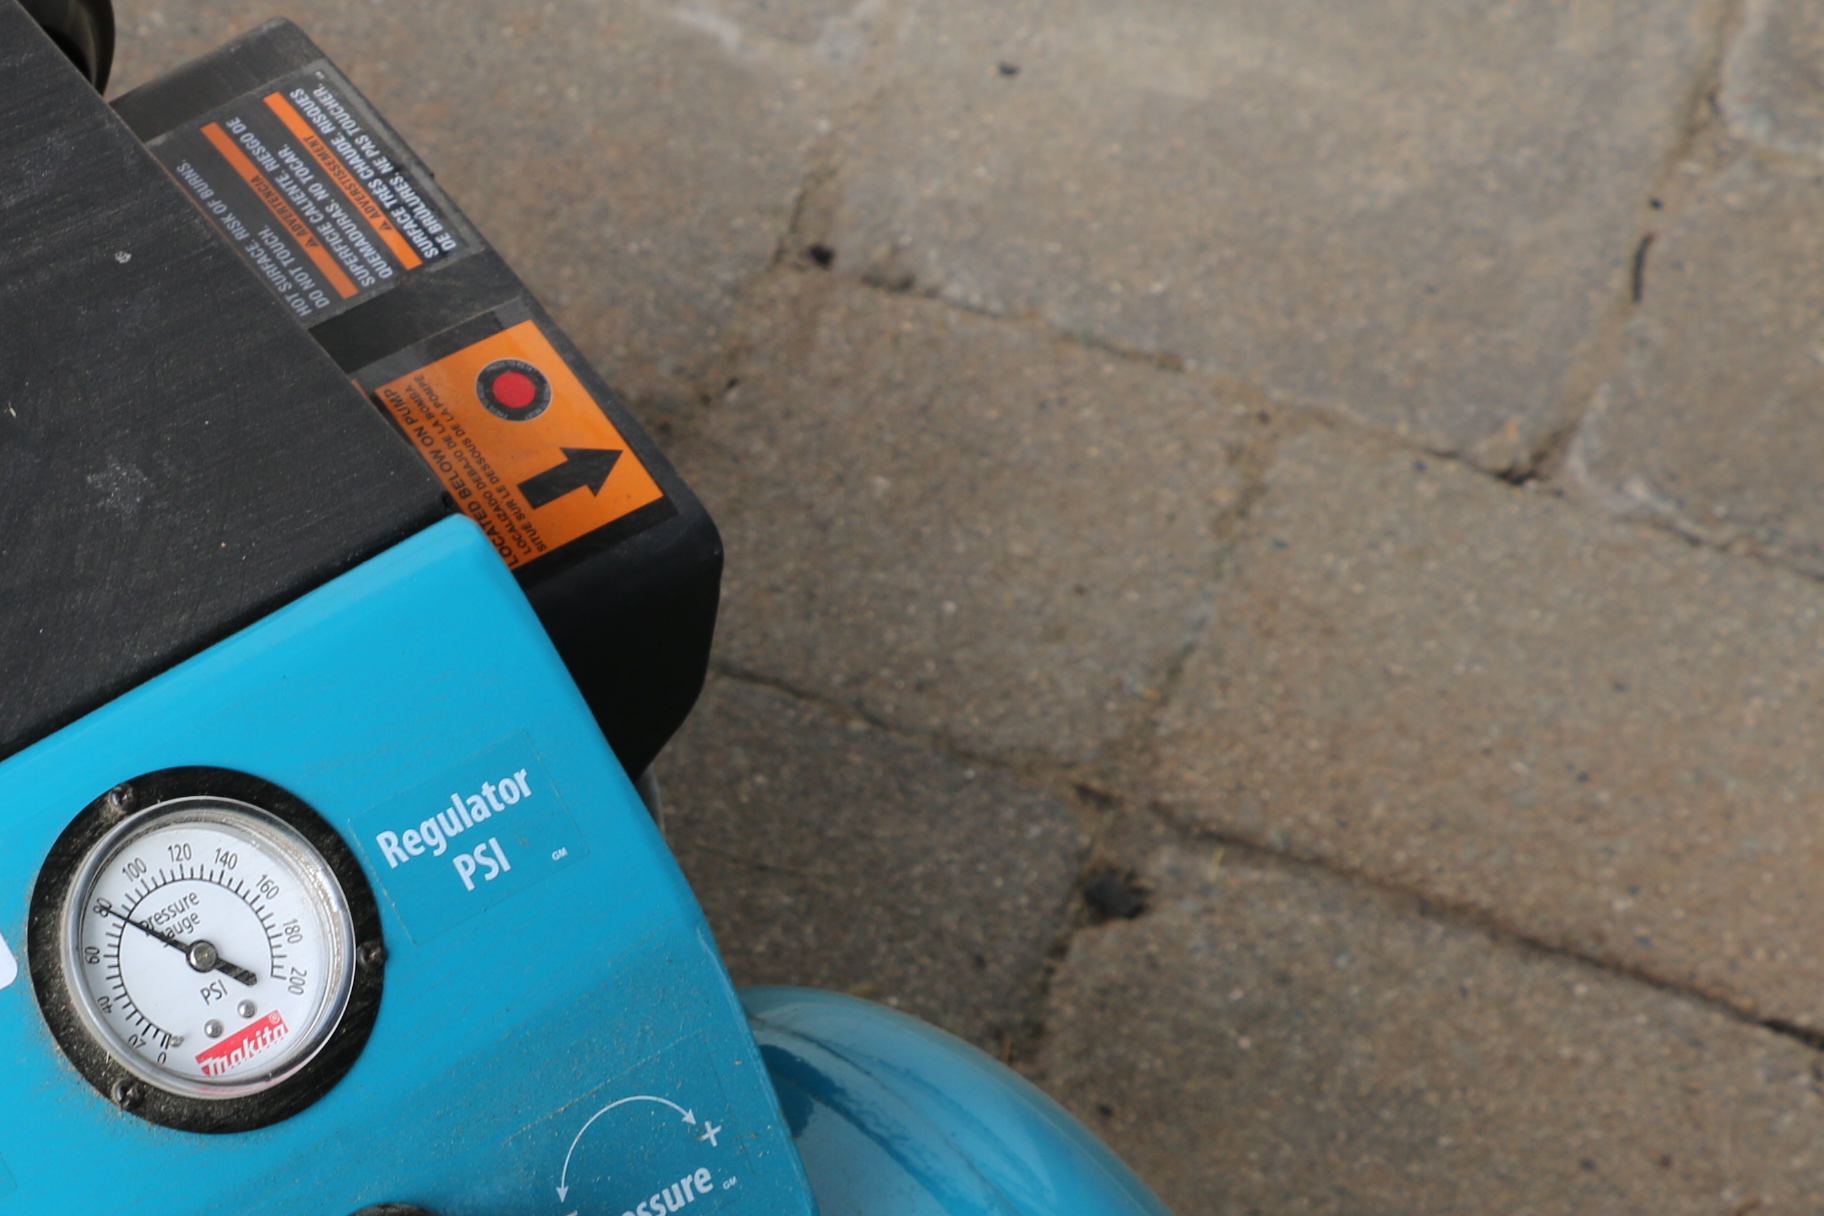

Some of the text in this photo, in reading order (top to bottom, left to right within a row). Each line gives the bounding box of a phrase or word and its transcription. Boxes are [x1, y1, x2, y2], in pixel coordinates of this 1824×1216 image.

[288, 88, 336, 135] RISQUES
[326, 131, 375, 180] CHAUDE.
[353, 133, 381, 158] PAS
[302, 133, 381, 220] ADVERSTISSEMENT
[371, 155, 395, 174] NE
[223, 115, 378, 287] SUPERFICIE CALIENTE. RIESGO DE
[248, 173, 308, 238] ADVERTENCIA
[306, 181, 330, 201] NO
[172, 158, 313, 317] HOT SURFACE. RISK OF BURNS.
[319, 198, 396, 279] QUEMADURAS.
[389, 206, 440, 258] SURFACE
[434, 232, 457, 251] DE
[254, 224, 331, 308] DO NOT TOUCH.
[412, 372, 445, 409] POMPE
[438, 407, 455, 422] LA
[449, 421, 466, 437] DE
[382, 385, 521, 566] LOCATED BELOW ON PUMP
[403, 383, 533, 555] LOCALIZADO DEBAJO DE LA BOMBA
[460, 436, 500, 484] DESSOUS
[494, 484, 510, 498] LE
[504, 498, 527, 521] SUR
[376, 768, 532, 869] Regulator
[168, 844, 192, 862] 120
[214, 848, 239, 870] 140
[452, 836, 512, 891] PSI
[122, 857, 147, 883] 100
[255, 874, 280, 899] 160
[283, 918, 303, 945] 180
[84, 946, 100, 965] 60
[200, 979, 228, 1006] PSI
[287, 967, 307, 996] 200
[196, 1022, 289, 1076] makita
